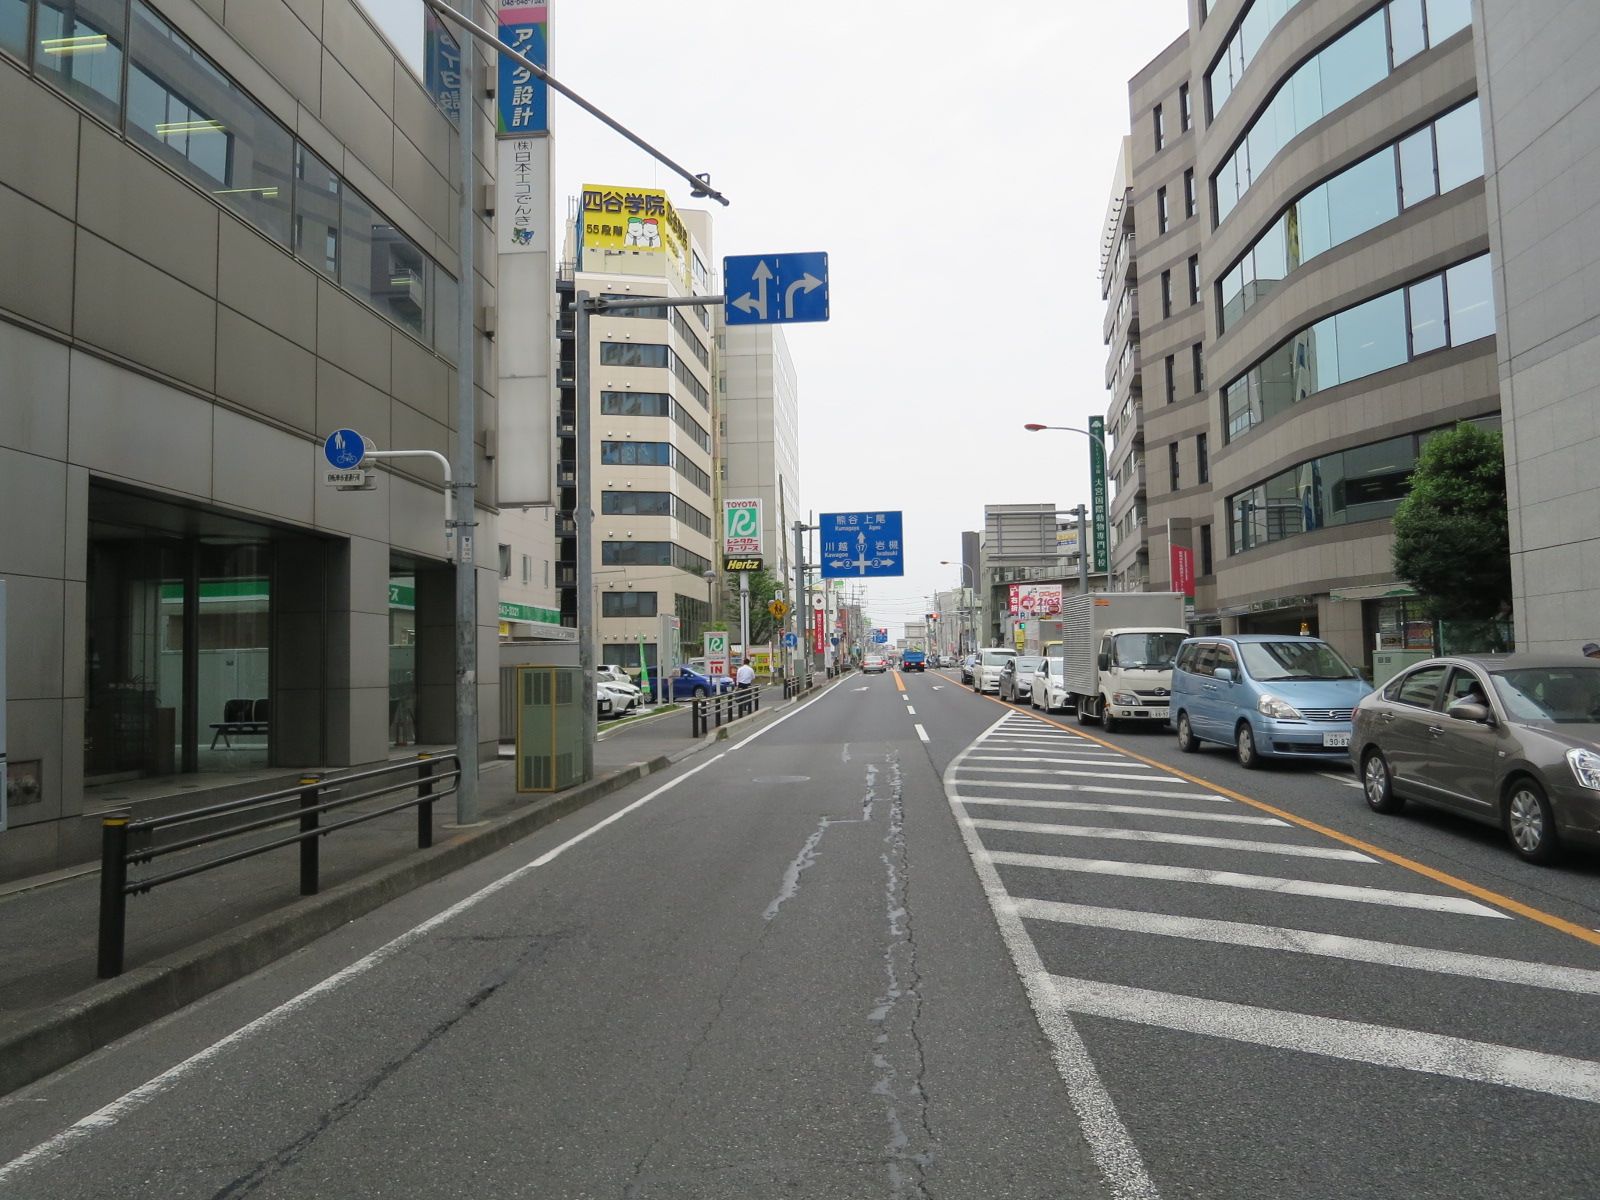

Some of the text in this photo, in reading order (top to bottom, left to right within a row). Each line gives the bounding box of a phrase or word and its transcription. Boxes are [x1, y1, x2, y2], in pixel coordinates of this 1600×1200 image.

[583, 190, 665, 217] 四谷学院
[726, 501, 758, 509] TOYOTA
[727, 559, 760, 571] Hertz
[711, 666, 722, 674] IN
